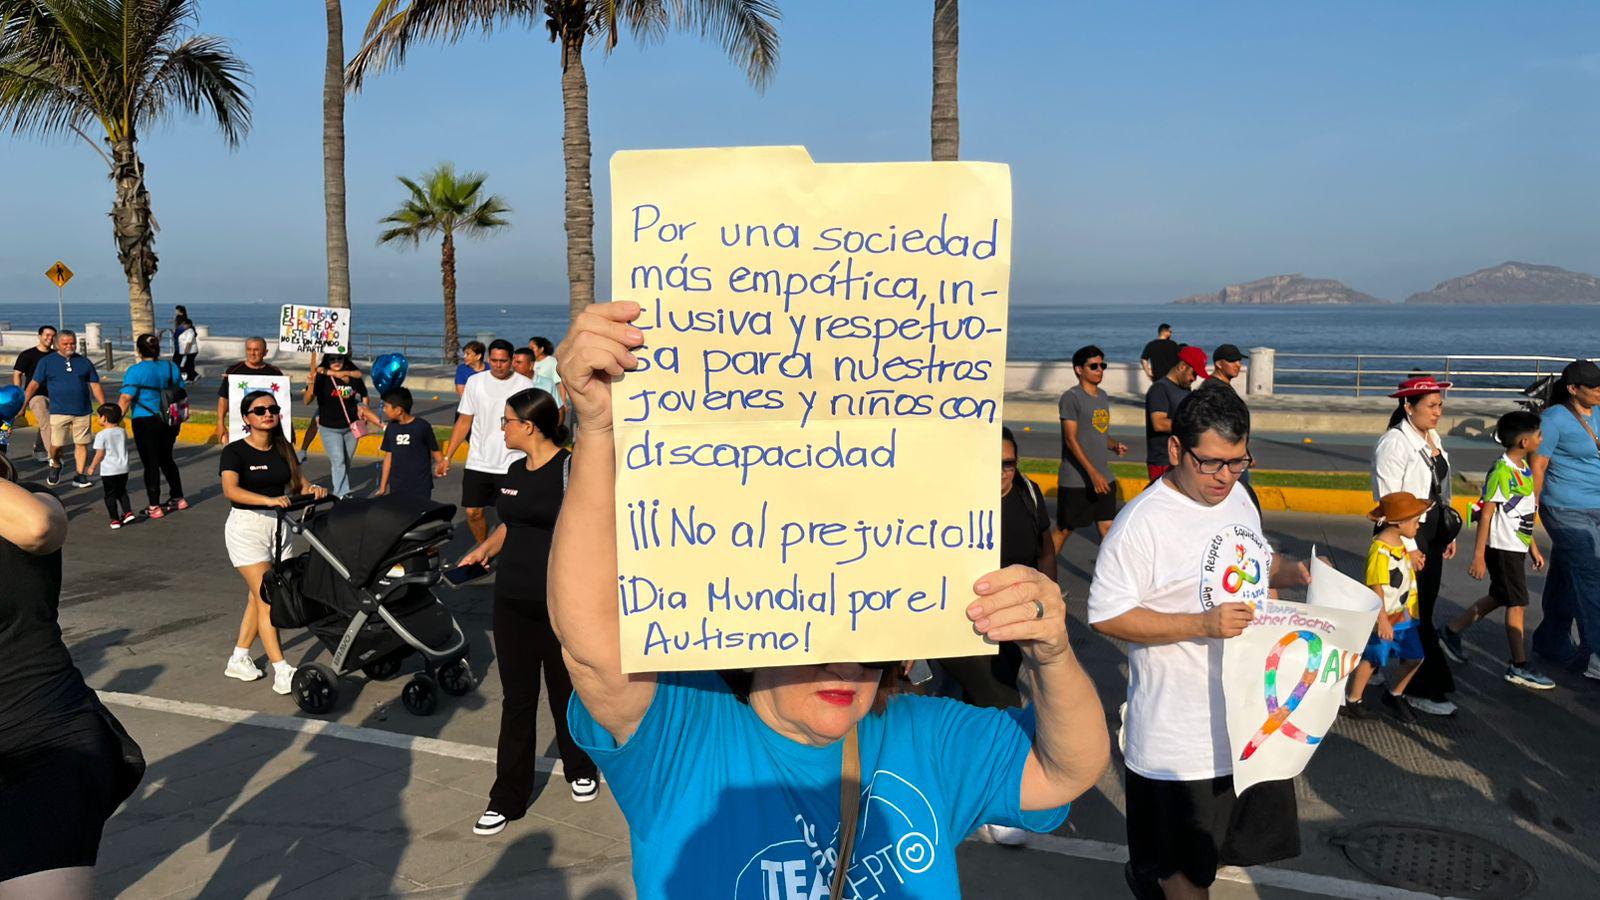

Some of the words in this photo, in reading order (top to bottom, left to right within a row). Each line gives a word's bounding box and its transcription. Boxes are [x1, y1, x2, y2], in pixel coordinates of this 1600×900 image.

[632, 204, 697, 243] Por
[720, 222, 801, 249] una
[813, 213, 998, 261] sociedad
[631, 253, 712, 292] más
[729, 257, 927, 313] empática,
[939, 280, 998, 306] in-
[324, 320, 336, 332] DE
[788, 314, 806, 357] y
[815, 303, 1002, 358] respetuo-
[703, 347, 813, 394] para
[834, 344, 992, 384] nuestros
[798, 391, 817, 428] y
[830, 389, 934, 417] niños
[939, 396, 996, 424] con
[396, 433, 411, 446] 92
[626, 428, 897, 486] discapacidad
[731, 501, 767, 549] al
[780, 510, 995, 565] prejuicio!!!
[1204, 534, 1223, 573] Respeto
[707, 573, 835, 616] Mundial
[848, 588, 901, 631] por
[906, 576, 947, 613] el
[1203, 586, 1216, 609] Amo
[333, 634, 352, 667] BRAVO
[643, 617, 811, 656] Autismo!
